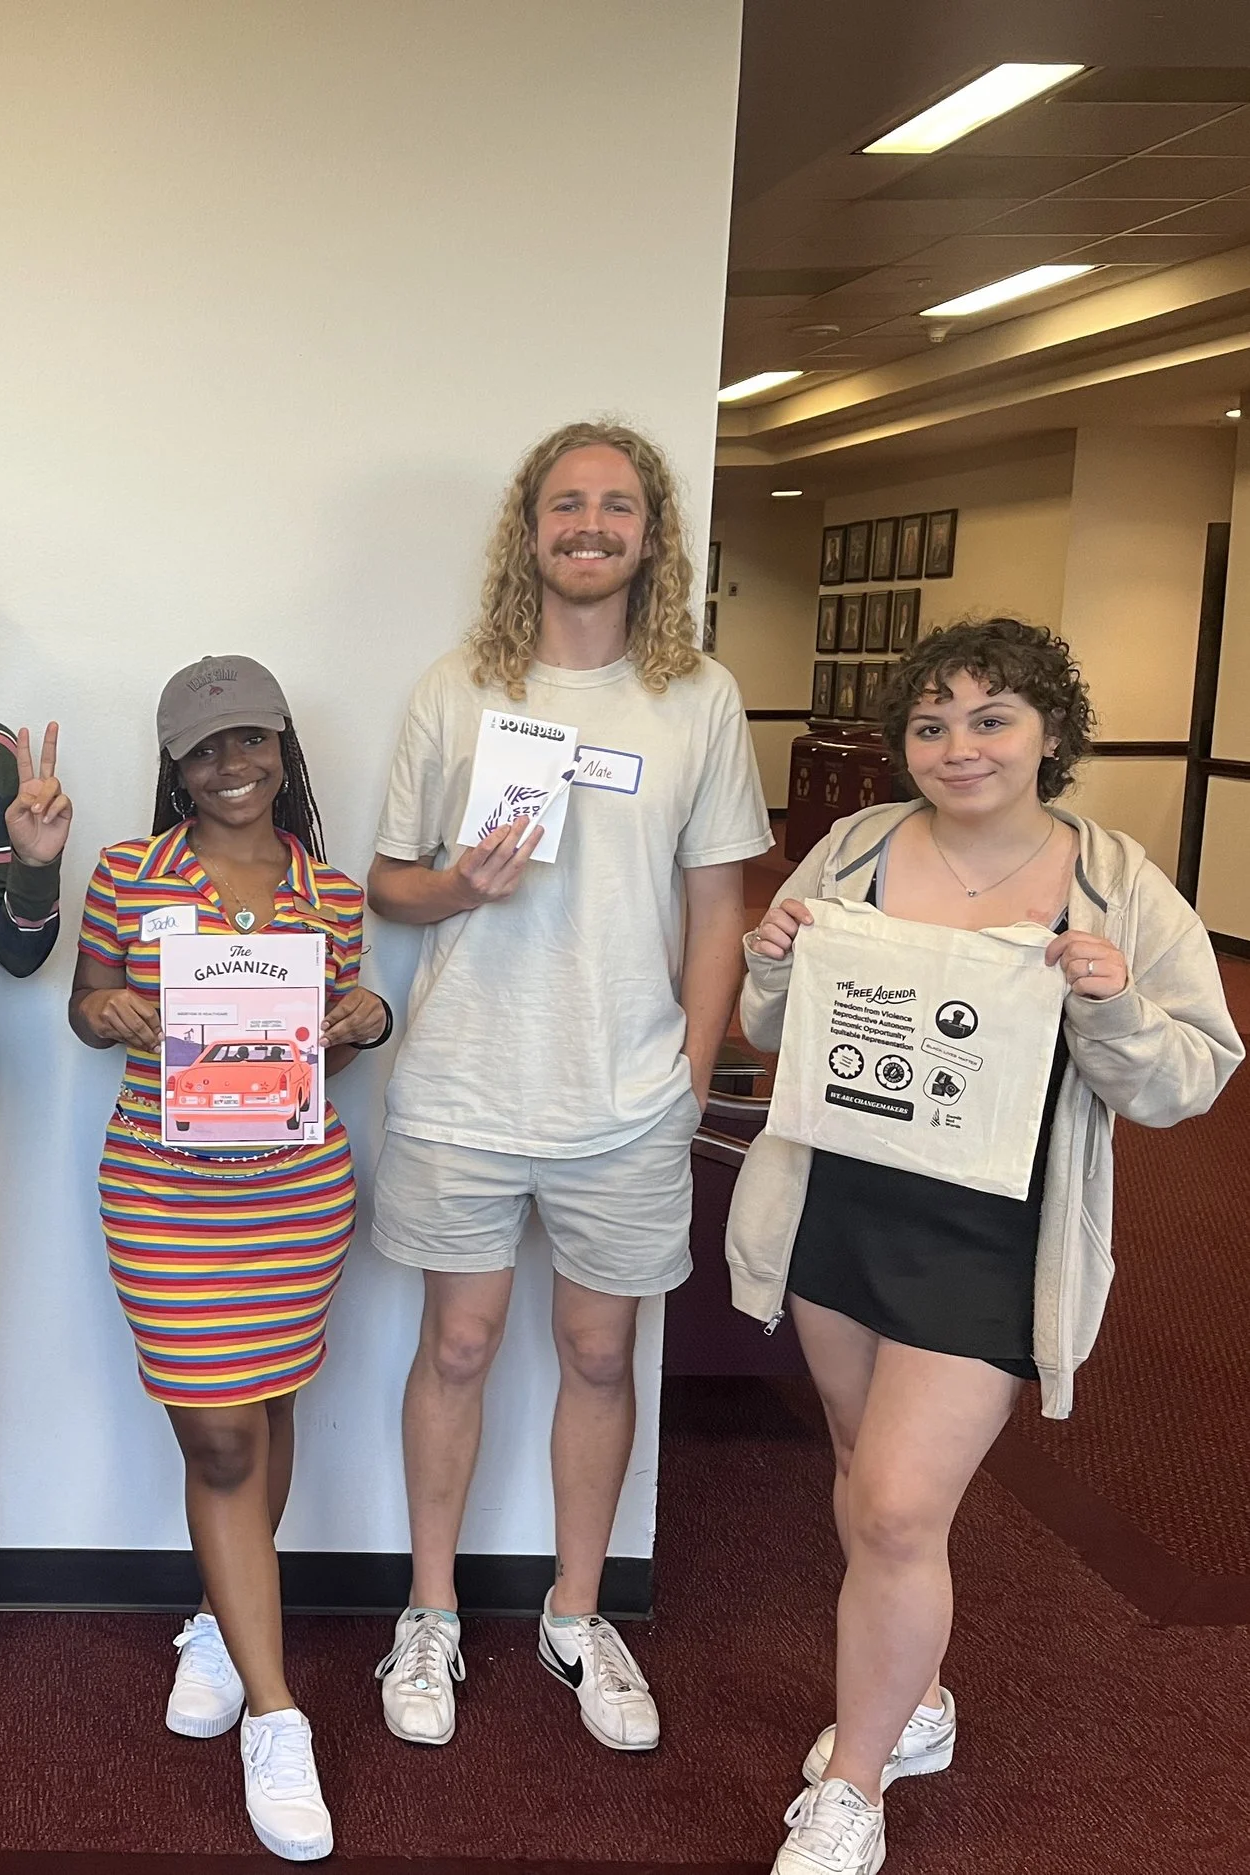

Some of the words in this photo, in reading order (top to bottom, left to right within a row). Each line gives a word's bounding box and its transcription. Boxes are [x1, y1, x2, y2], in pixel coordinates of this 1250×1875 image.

[499, 718, 518, 732] DO
[518, 721, 539, 737] THE
[539, 726, 565, 741] DEED
[583, 760, 612, 779] Nate
[147, 916, 178, 932] Jada
[230, 945, 252, 957] The
[194, 961, 288, 981] GALVANIZER
[836, 981, 855, 990] THE
[847, 988, 873, 998] FREE
[869, 985, 916, 1002] AGENDA
[833, 1009, 878, 1025] Reproductive
[878, 1020, 915, 1033] Autonomy
[834, 1000, 863, 1012] Freedom
[864, 1007, 880, 1016] from
[881, 1010, 912, 1022] Violence
[830, 1027, 860, 1039] Equitable
[861, 1034, 913, 1051] Representation
[831, 1018, 862, 1030] Economic
[863, 1025, 906, 1041] Opportunity
[841, 1094, 854, 1103] ARE
[854, 1098, 908, 1114] CHANGEMAKERS
